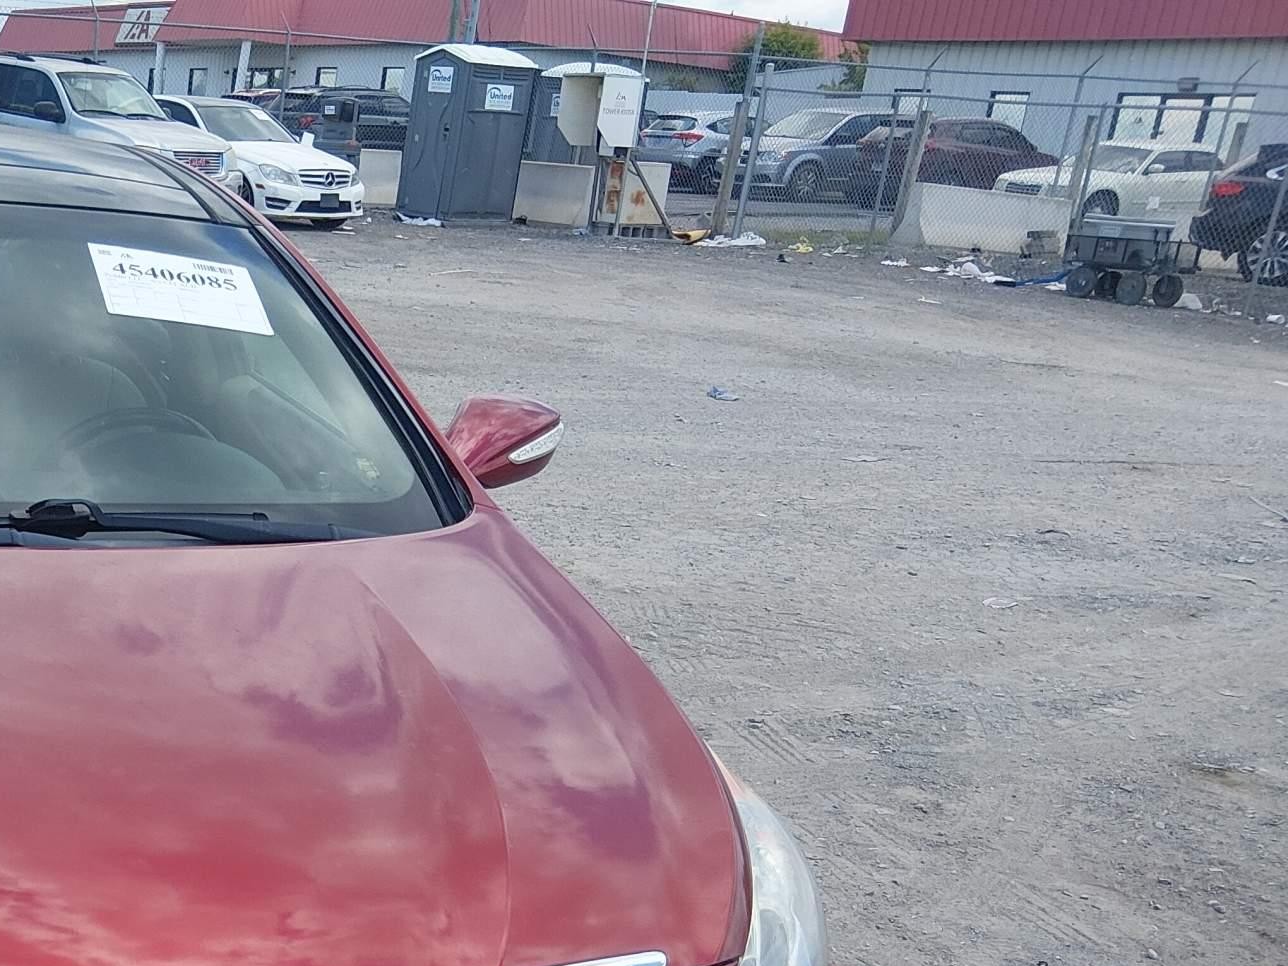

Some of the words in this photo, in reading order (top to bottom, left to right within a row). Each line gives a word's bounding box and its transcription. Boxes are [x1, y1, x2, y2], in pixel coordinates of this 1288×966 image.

[432, 73, 451, 82] United
[489, 90, 512, 101] United
[112, 262, 238, 292] 45406085
